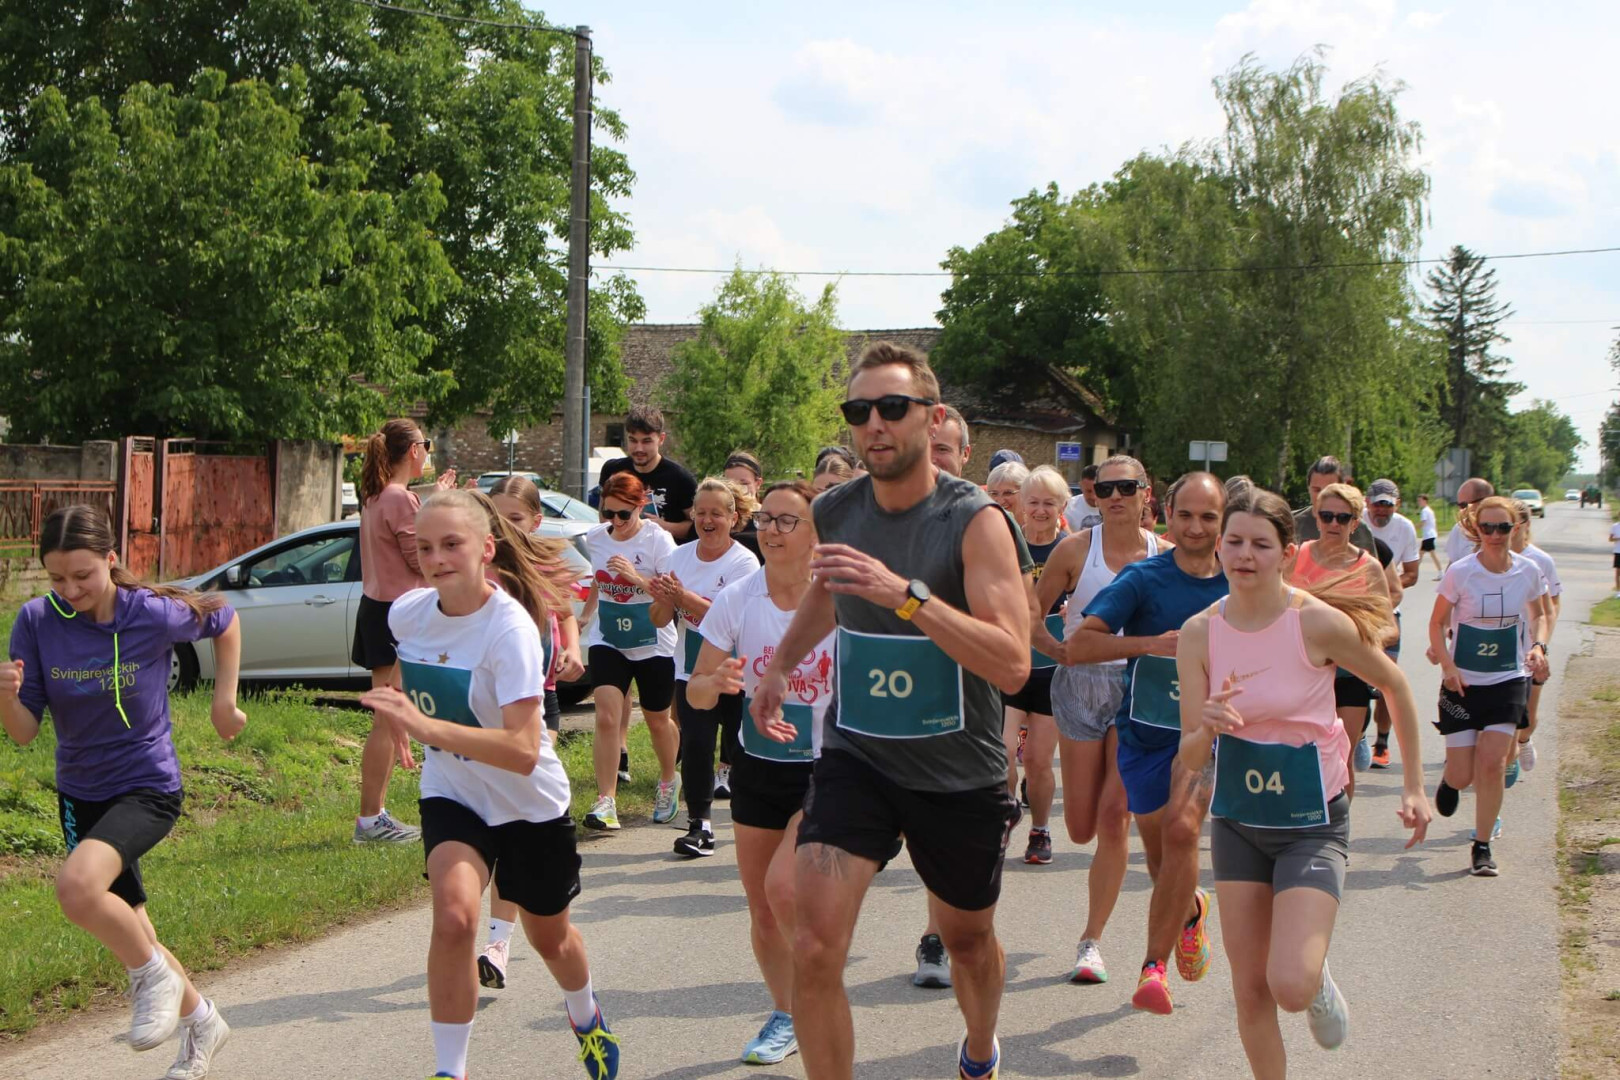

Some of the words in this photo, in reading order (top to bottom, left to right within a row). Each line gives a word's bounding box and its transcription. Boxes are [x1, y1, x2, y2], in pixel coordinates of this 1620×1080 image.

[616, 617, 633, 632] 19
[1476, 642, 1499, 657] 22
[98, 673, 136, 691] 1200
[868, 668, 913, 698] 20
[410, 689, 436, 716] 10
[1245, 768, 1285, 795] 04
